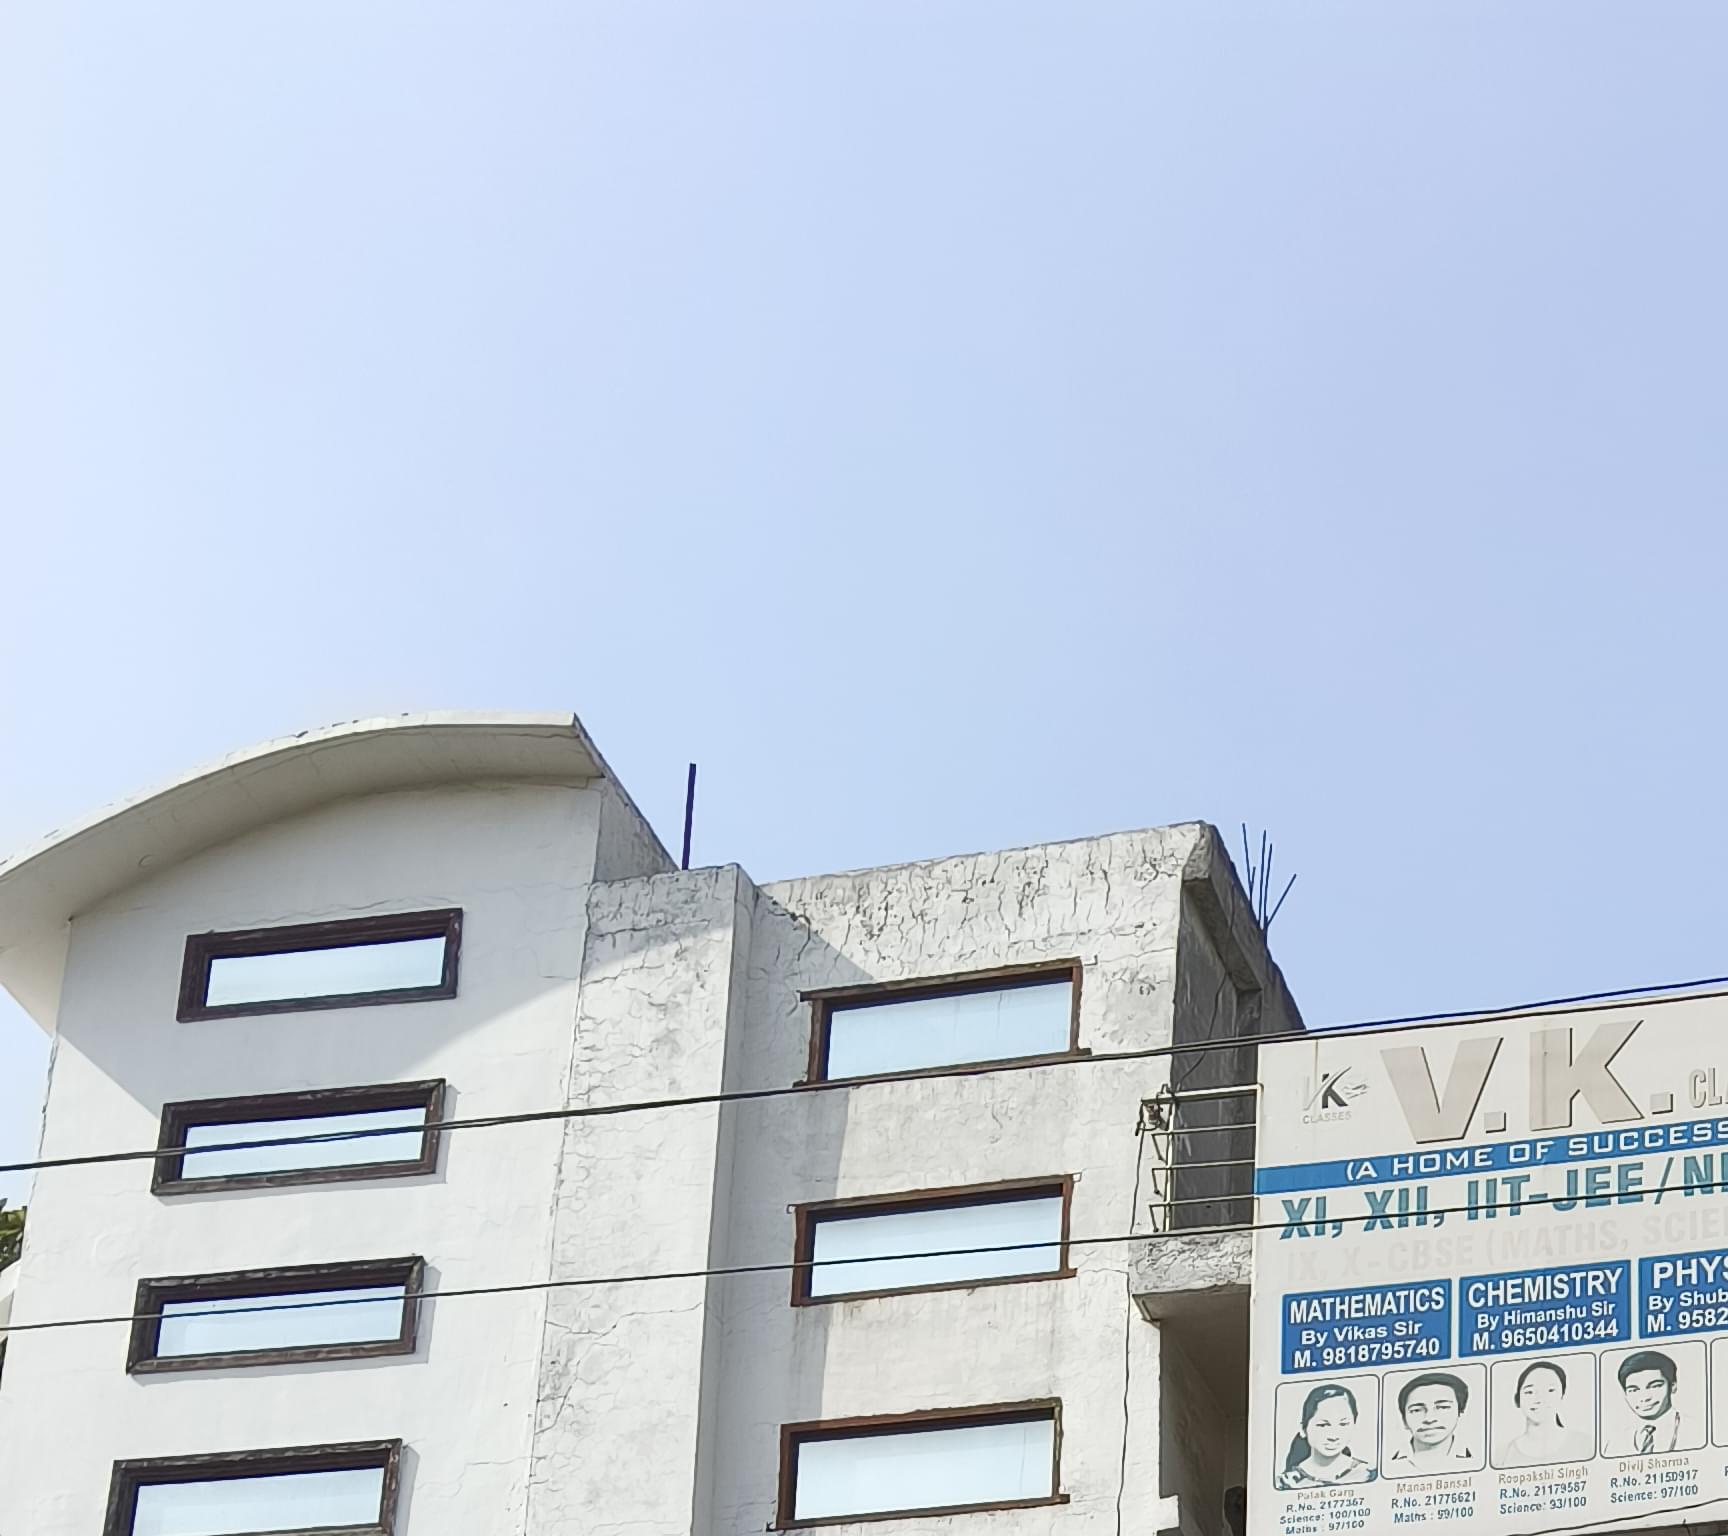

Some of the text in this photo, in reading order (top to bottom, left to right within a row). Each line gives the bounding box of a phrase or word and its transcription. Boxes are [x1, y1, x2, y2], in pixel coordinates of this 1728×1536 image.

[1345, 1158, 1380, 1182] (A
[1393, 1145, 1494, 1176] HOME
[1510, 1140, 1549, 1163] OF
[1280, 1186, 1445, 1239] XI, XII,
[1467, 1267, 1623, 1309] CHEMISTRY
[1648, 1292, 1674, 1312] By
[1289, 1286, 1445, 1324] MATHEMATICS
[1476, 1301, 1616, 1331] By Himanshu Sir
[1302, 1319, 1423, 1346] By Vikas Sir
[1472, 1319, 1618, 1349] M. 9650410344
[1647, 1314, 1672, 1333] M.
[1294, 1337, 1441, 1368] M. 9818795740
